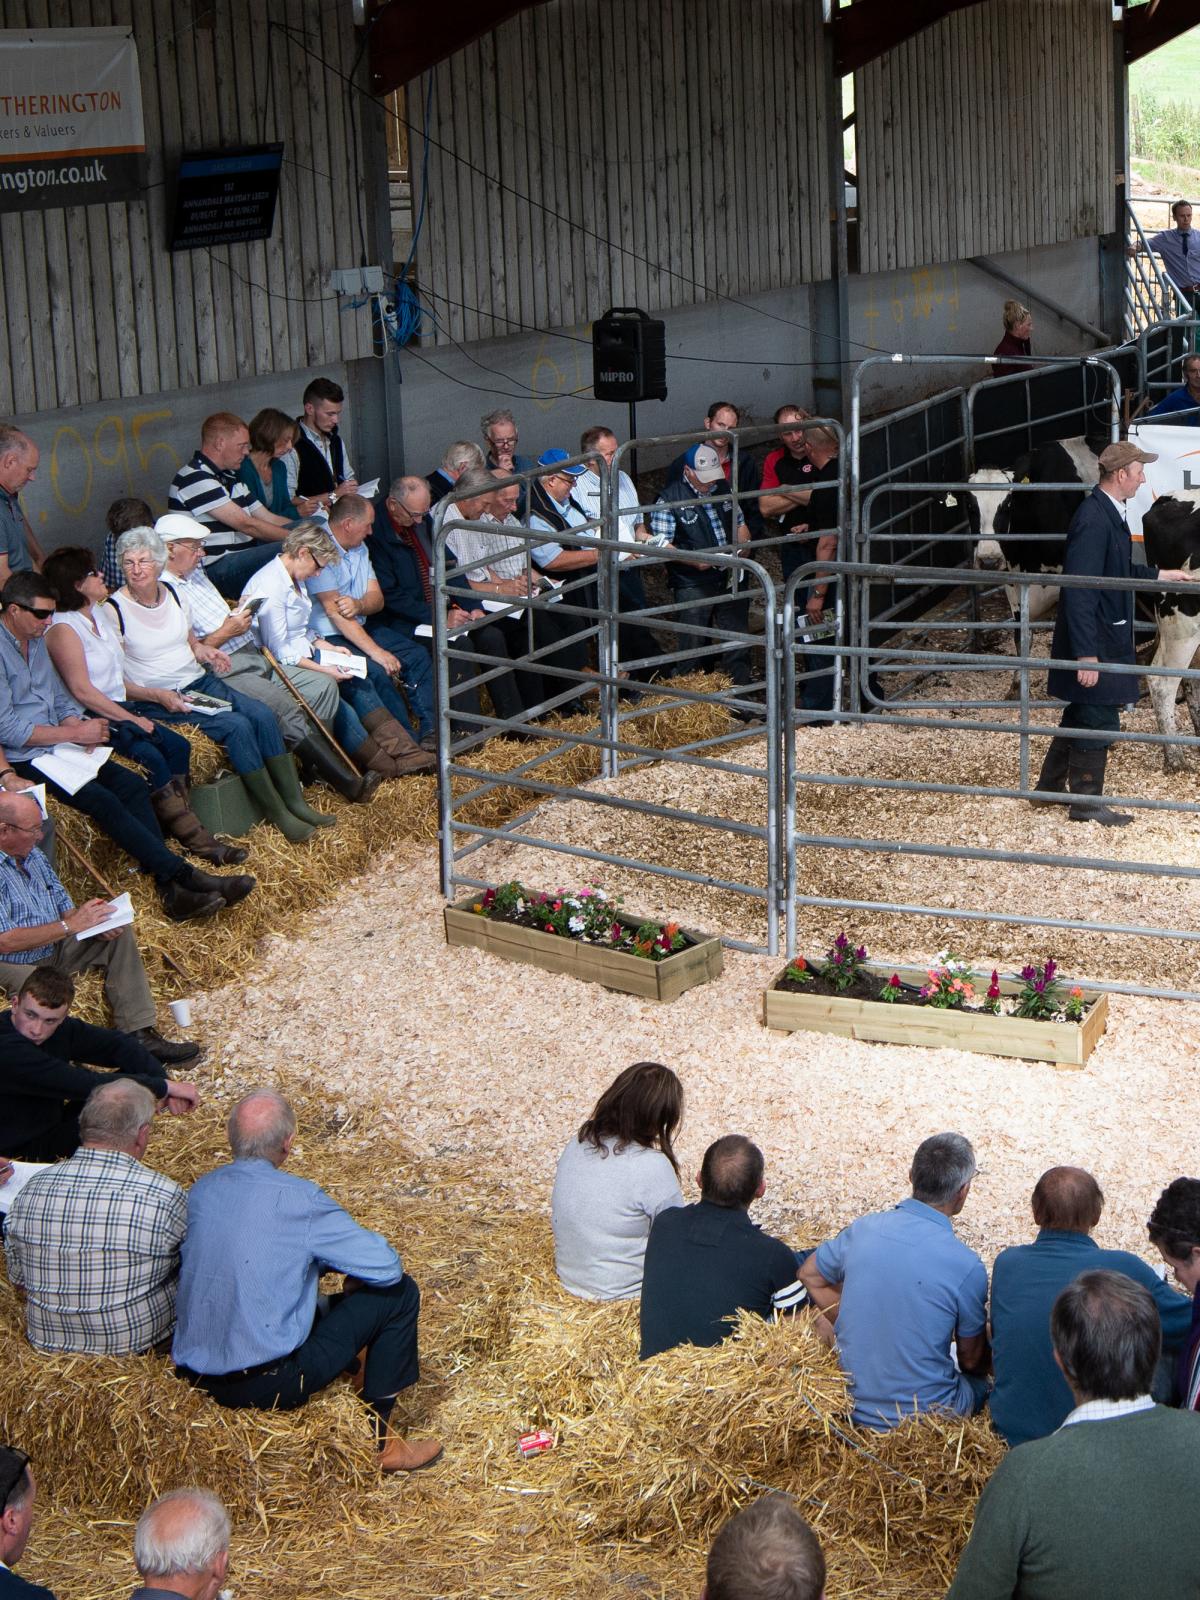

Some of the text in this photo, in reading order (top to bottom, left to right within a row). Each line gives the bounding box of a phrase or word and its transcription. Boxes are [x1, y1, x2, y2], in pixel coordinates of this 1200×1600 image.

[24, 125, 31, 138] &
[33, 124, 76, 137] Valuers
[0, 159, 107, 194] ngton.co.uk
